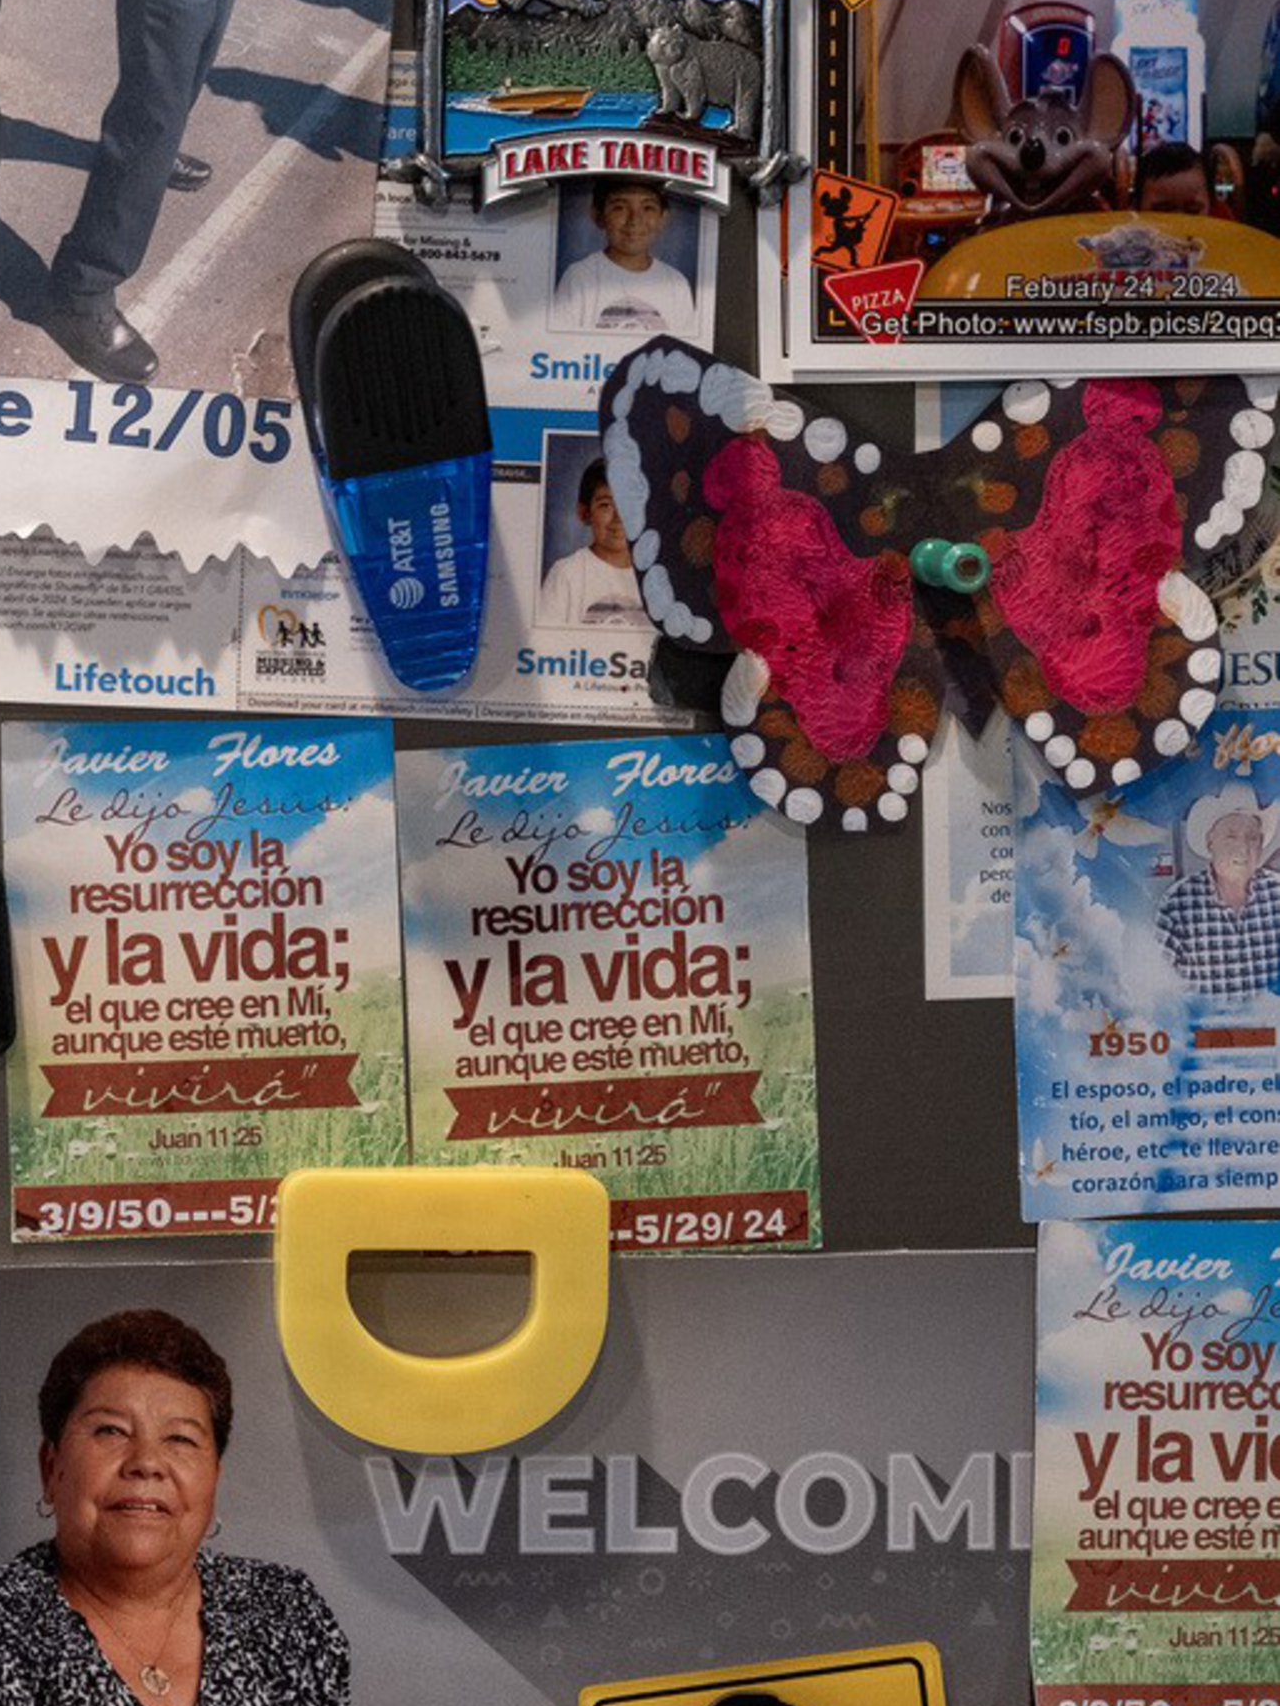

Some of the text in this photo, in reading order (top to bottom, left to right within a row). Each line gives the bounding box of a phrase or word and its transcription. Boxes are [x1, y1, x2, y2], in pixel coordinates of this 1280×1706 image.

[504, 139, 710, 180] LAKE TAHOE
[851, 288, 906, 312] PIZZA
[64, 380, 293, 464] 12/05
[389, 517, 411, 573] AT&T
[440, 499, 462, 607] SAMSUNG
[54, 661, 216, 698] Lifetouch
